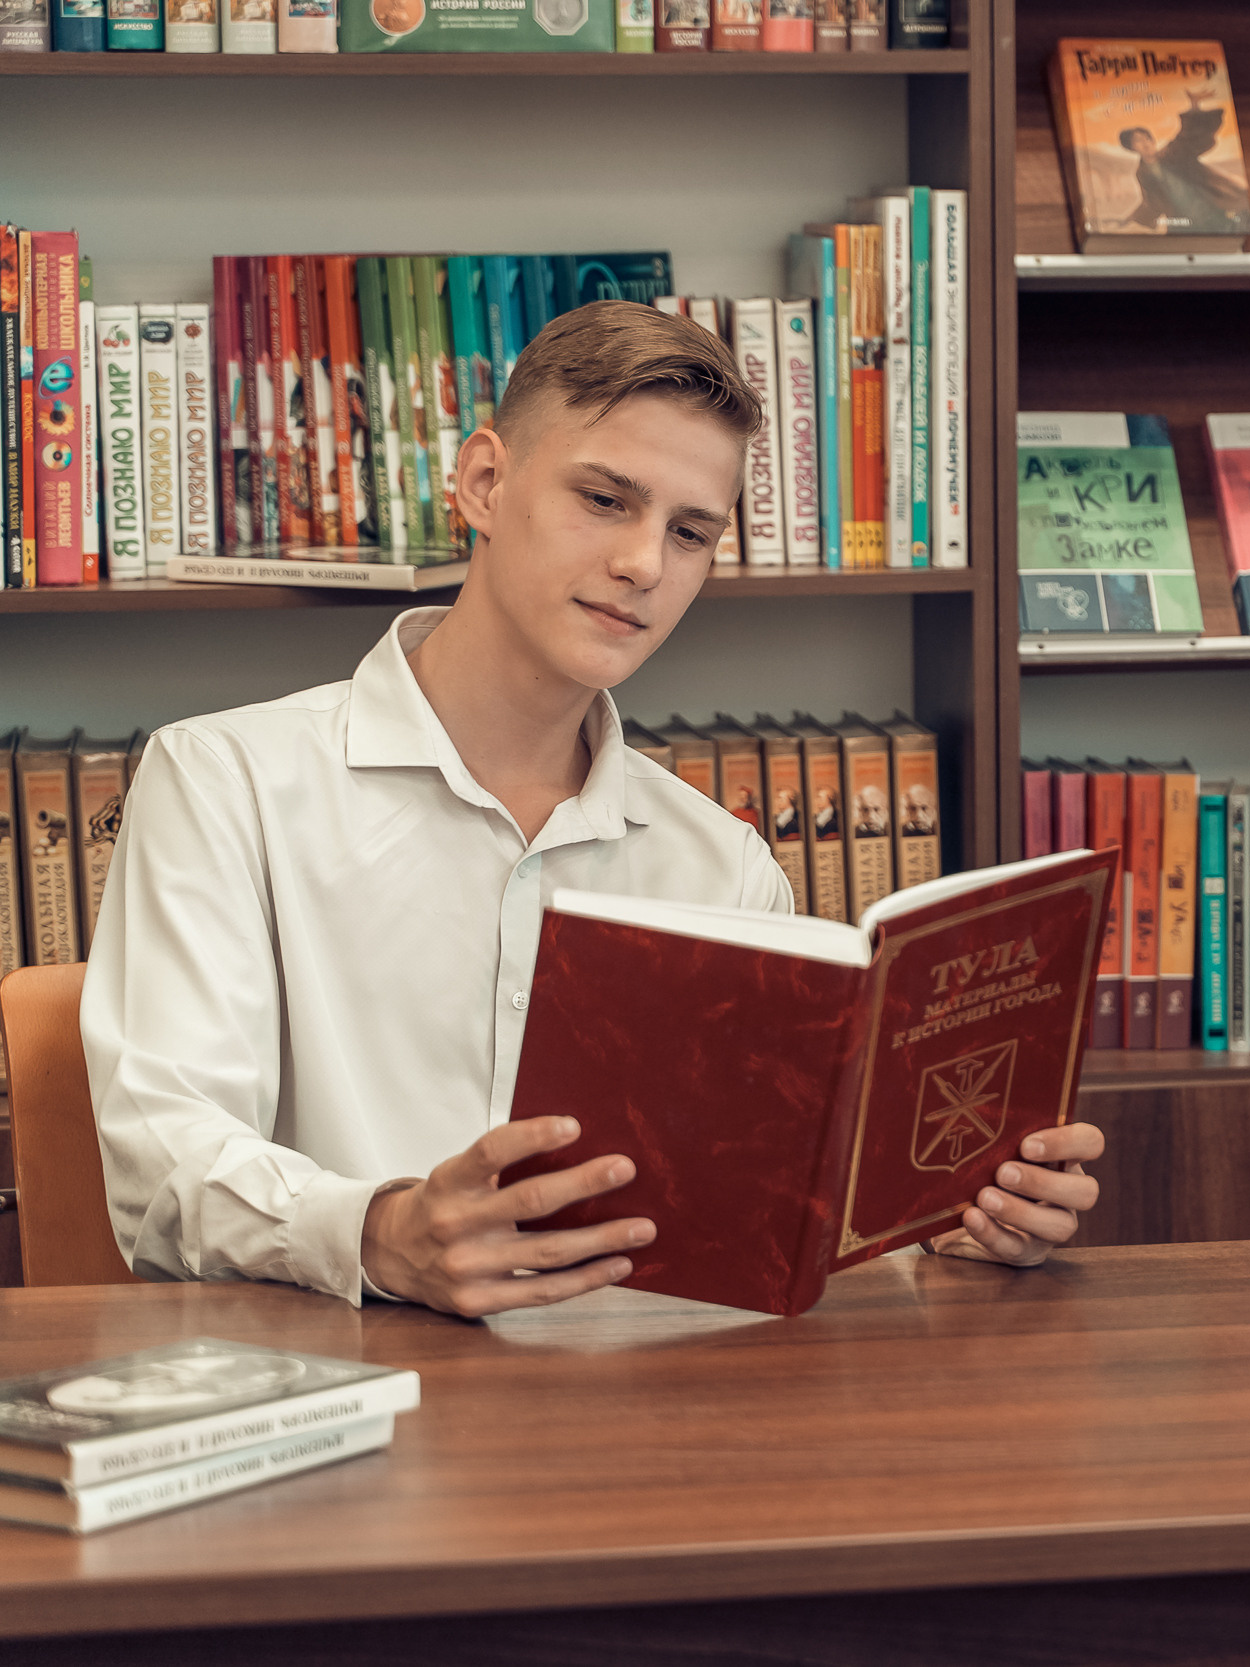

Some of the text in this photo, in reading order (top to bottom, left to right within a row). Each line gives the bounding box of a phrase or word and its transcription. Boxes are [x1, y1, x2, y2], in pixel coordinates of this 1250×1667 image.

[946, 203, 958, 284] БОЛЬШАЯ
[59, 253, 76, 350] ШКОЛЬНИКА
[185, 371, 207, 423] МИР
[108, 361, 140, 559] Я ПОЗНАЮ МИР
[147, 370, 175, 546] Я ПОЗНАЮ МИР
[186, 427, 208, 527] ПОЗНАЮ
[789, 356, 818, 543] Я ПОЗНАЮ МИР
[187, 529, 210, 550] Я
[751, 522, 776, 540] Я
[930, 935, 1041, 995] ТУЛА
[906, 1000, 994, 1045] ИСТОРИИ
[992, 981, 1064, 1015] ГОРОДА
